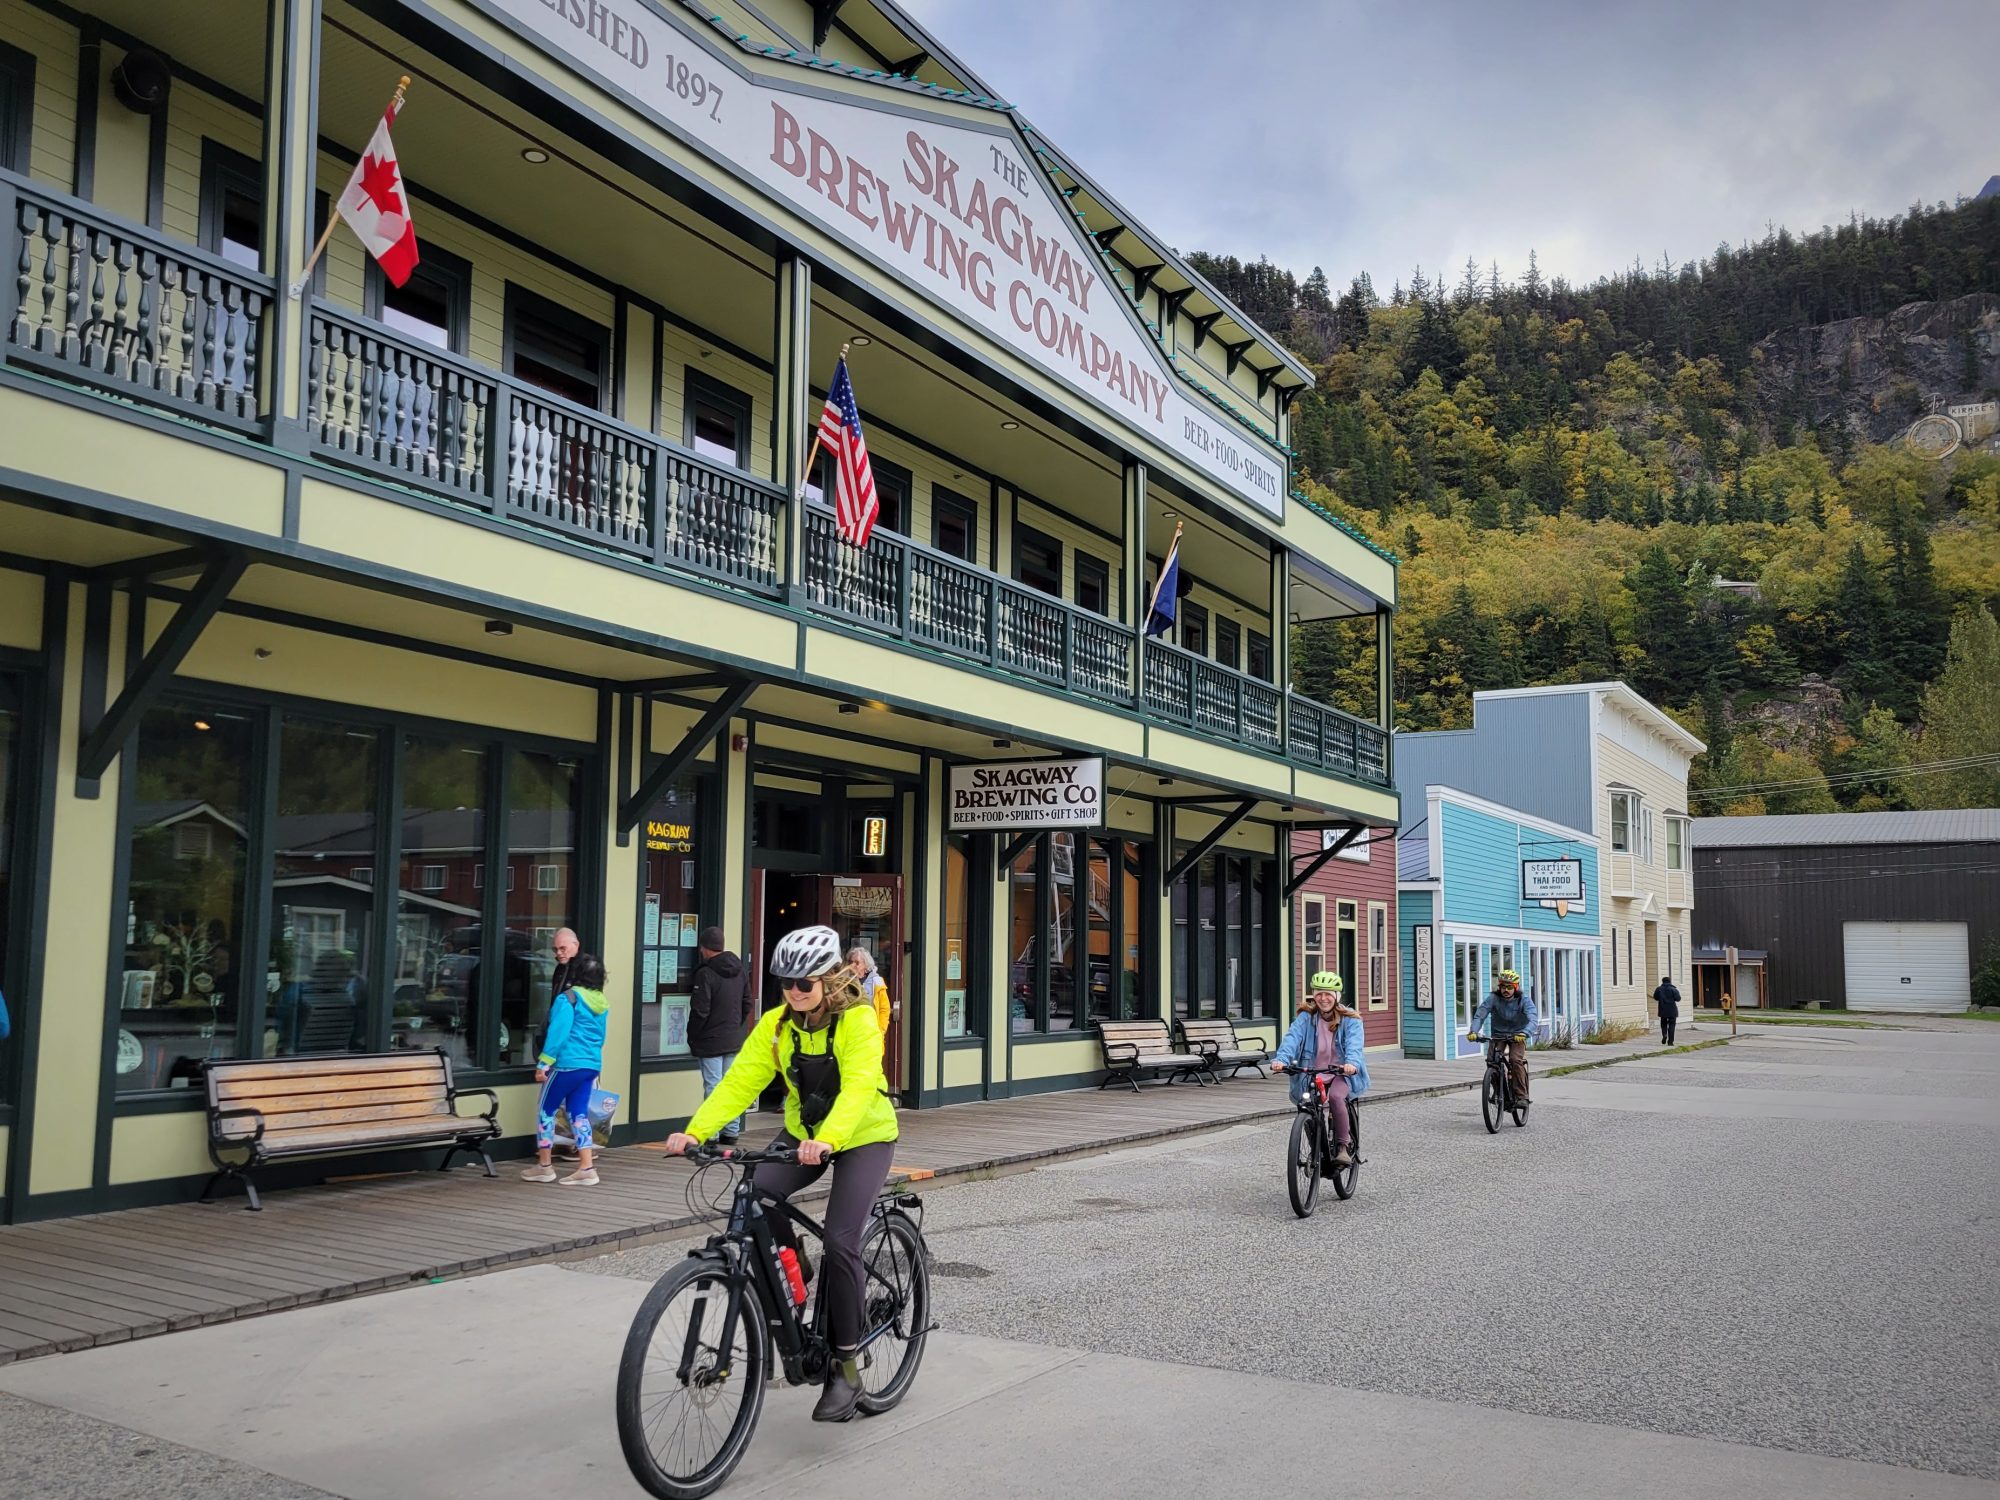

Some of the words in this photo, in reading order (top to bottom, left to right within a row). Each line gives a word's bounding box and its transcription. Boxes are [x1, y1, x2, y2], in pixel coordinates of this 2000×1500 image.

[989, 144, 1030, 199] THE
[903, 130, 1096, 315] SKAGWAY
[770, 100, 997, 312] BREWING
[1008, 279, 1170, 424] COMPANY
[1183, 416, 1210, 454] BEER
[1215, 437, 1239, 472] FOOD
[1244, 458, 1276, 497] SPIRITS
[972, 766, 1078, 788] SKAGWAY
[953, 811, 976, 823] BEER
[981, 810, 1004, 822] FOOD
[1010, 809, 1045, 821] SPIRITS
[1051, 808, 1072, 820] GIFT
[1074, 807, 1098, 819] SHOP
[954, 788, 1058, 809] BREWING
[870, 820, 880, 854] OPEN
[1531, 862, 1571, 871] starfire
[1552, 876, 1571, 884] FOOD
[1418, 928, 1430, 1007] RESTAURANT
